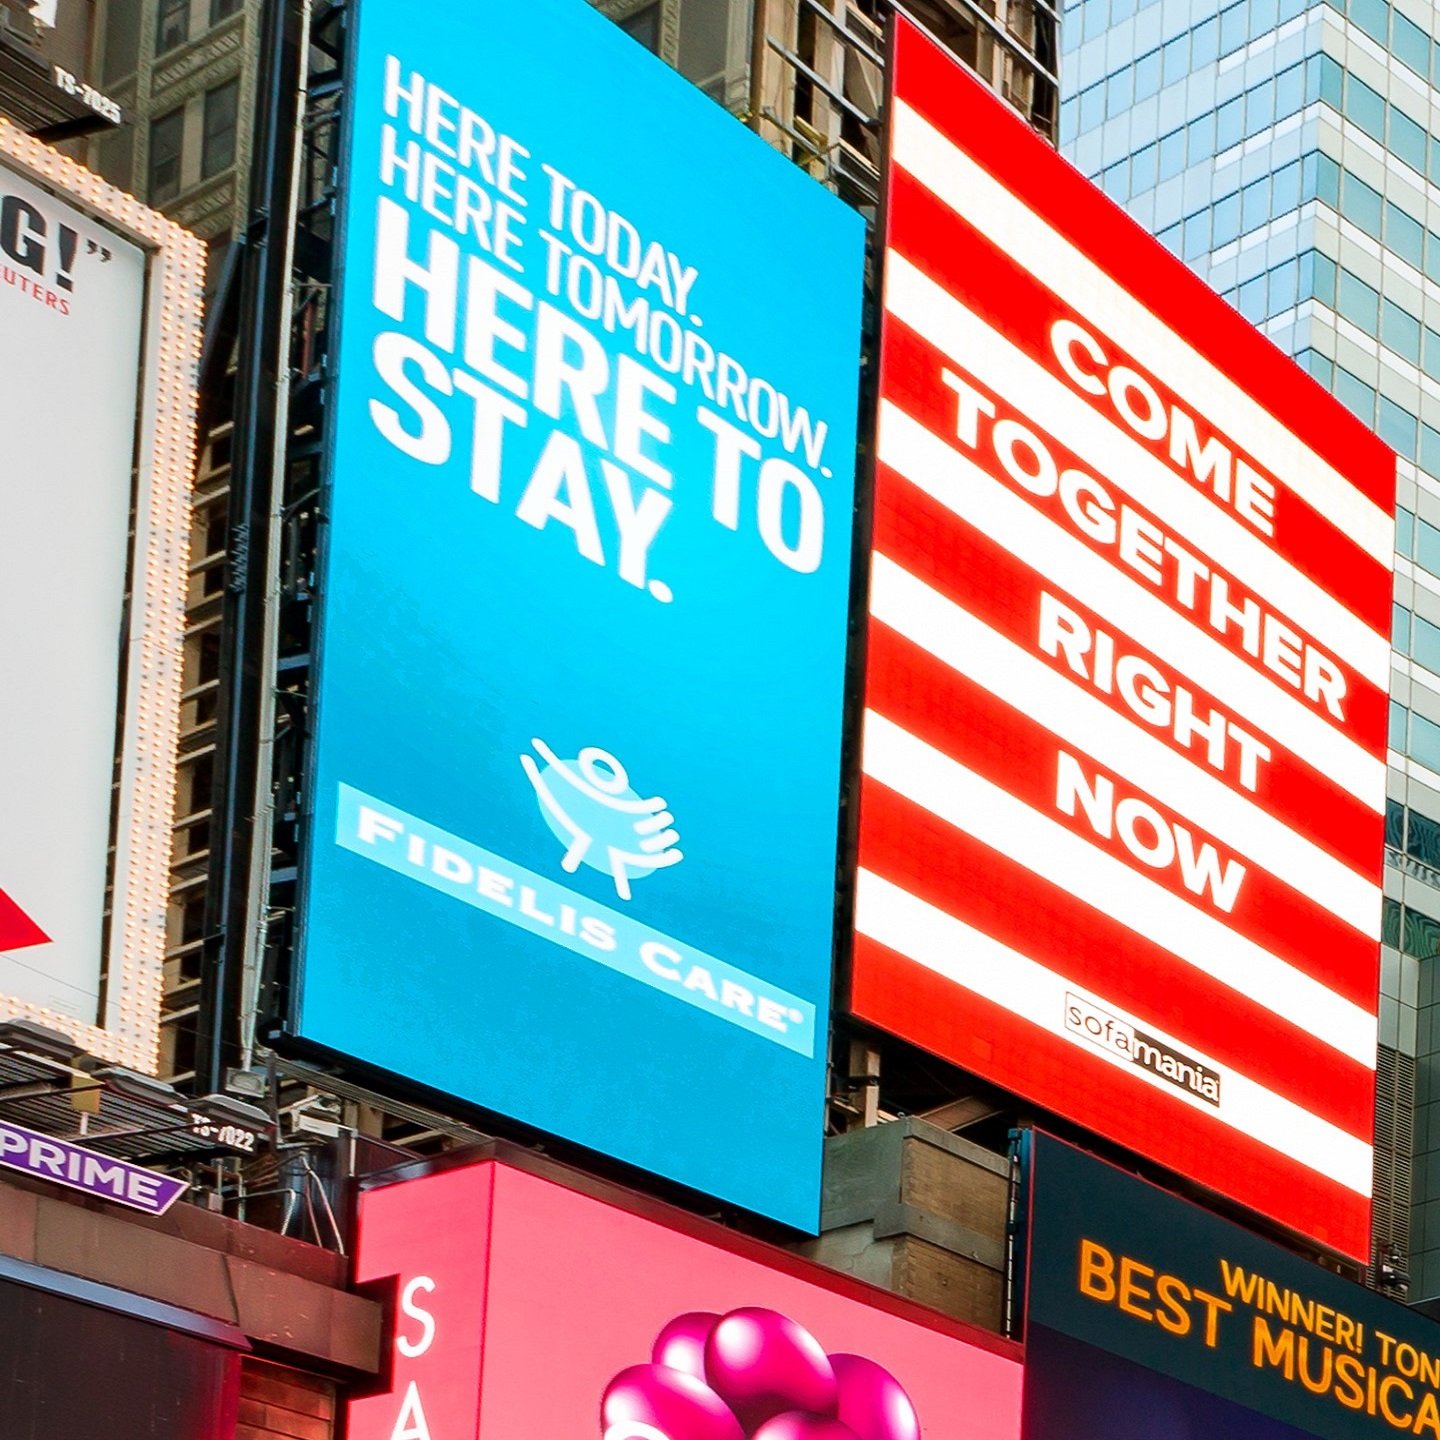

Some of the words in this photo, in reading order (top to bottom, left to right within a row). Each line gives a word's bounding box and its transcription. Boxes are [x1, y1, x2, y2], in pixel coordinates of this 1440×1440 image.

[384, 54, 530, 182] HERE
[541, 163, 704, 327] TODAY.
[374, 197, 676, 491] HERE
[698, 407, 824, 574] TO
[379, 125, 524, 274] HERE
[540, 228, 834, 480] TOMORROW.
[369, 332, 674, 604] STAY.
[1050, 319, 1278, 537] COME
[941, 368, 1348, 722] TOGETHER
[1038, 590, 1271, 793] RIGHT
[357, 804, 616, 952] FIDELIS
[1056, 751, 1247, 913] NOW
[1068, 1000, 1220, 1102] sofamania
[0, 1134, 162, 1207] PRIME
[1078, 1238, 1231, 1347] BEST
[1220, 1258, 1363, 1351] WINNER!
